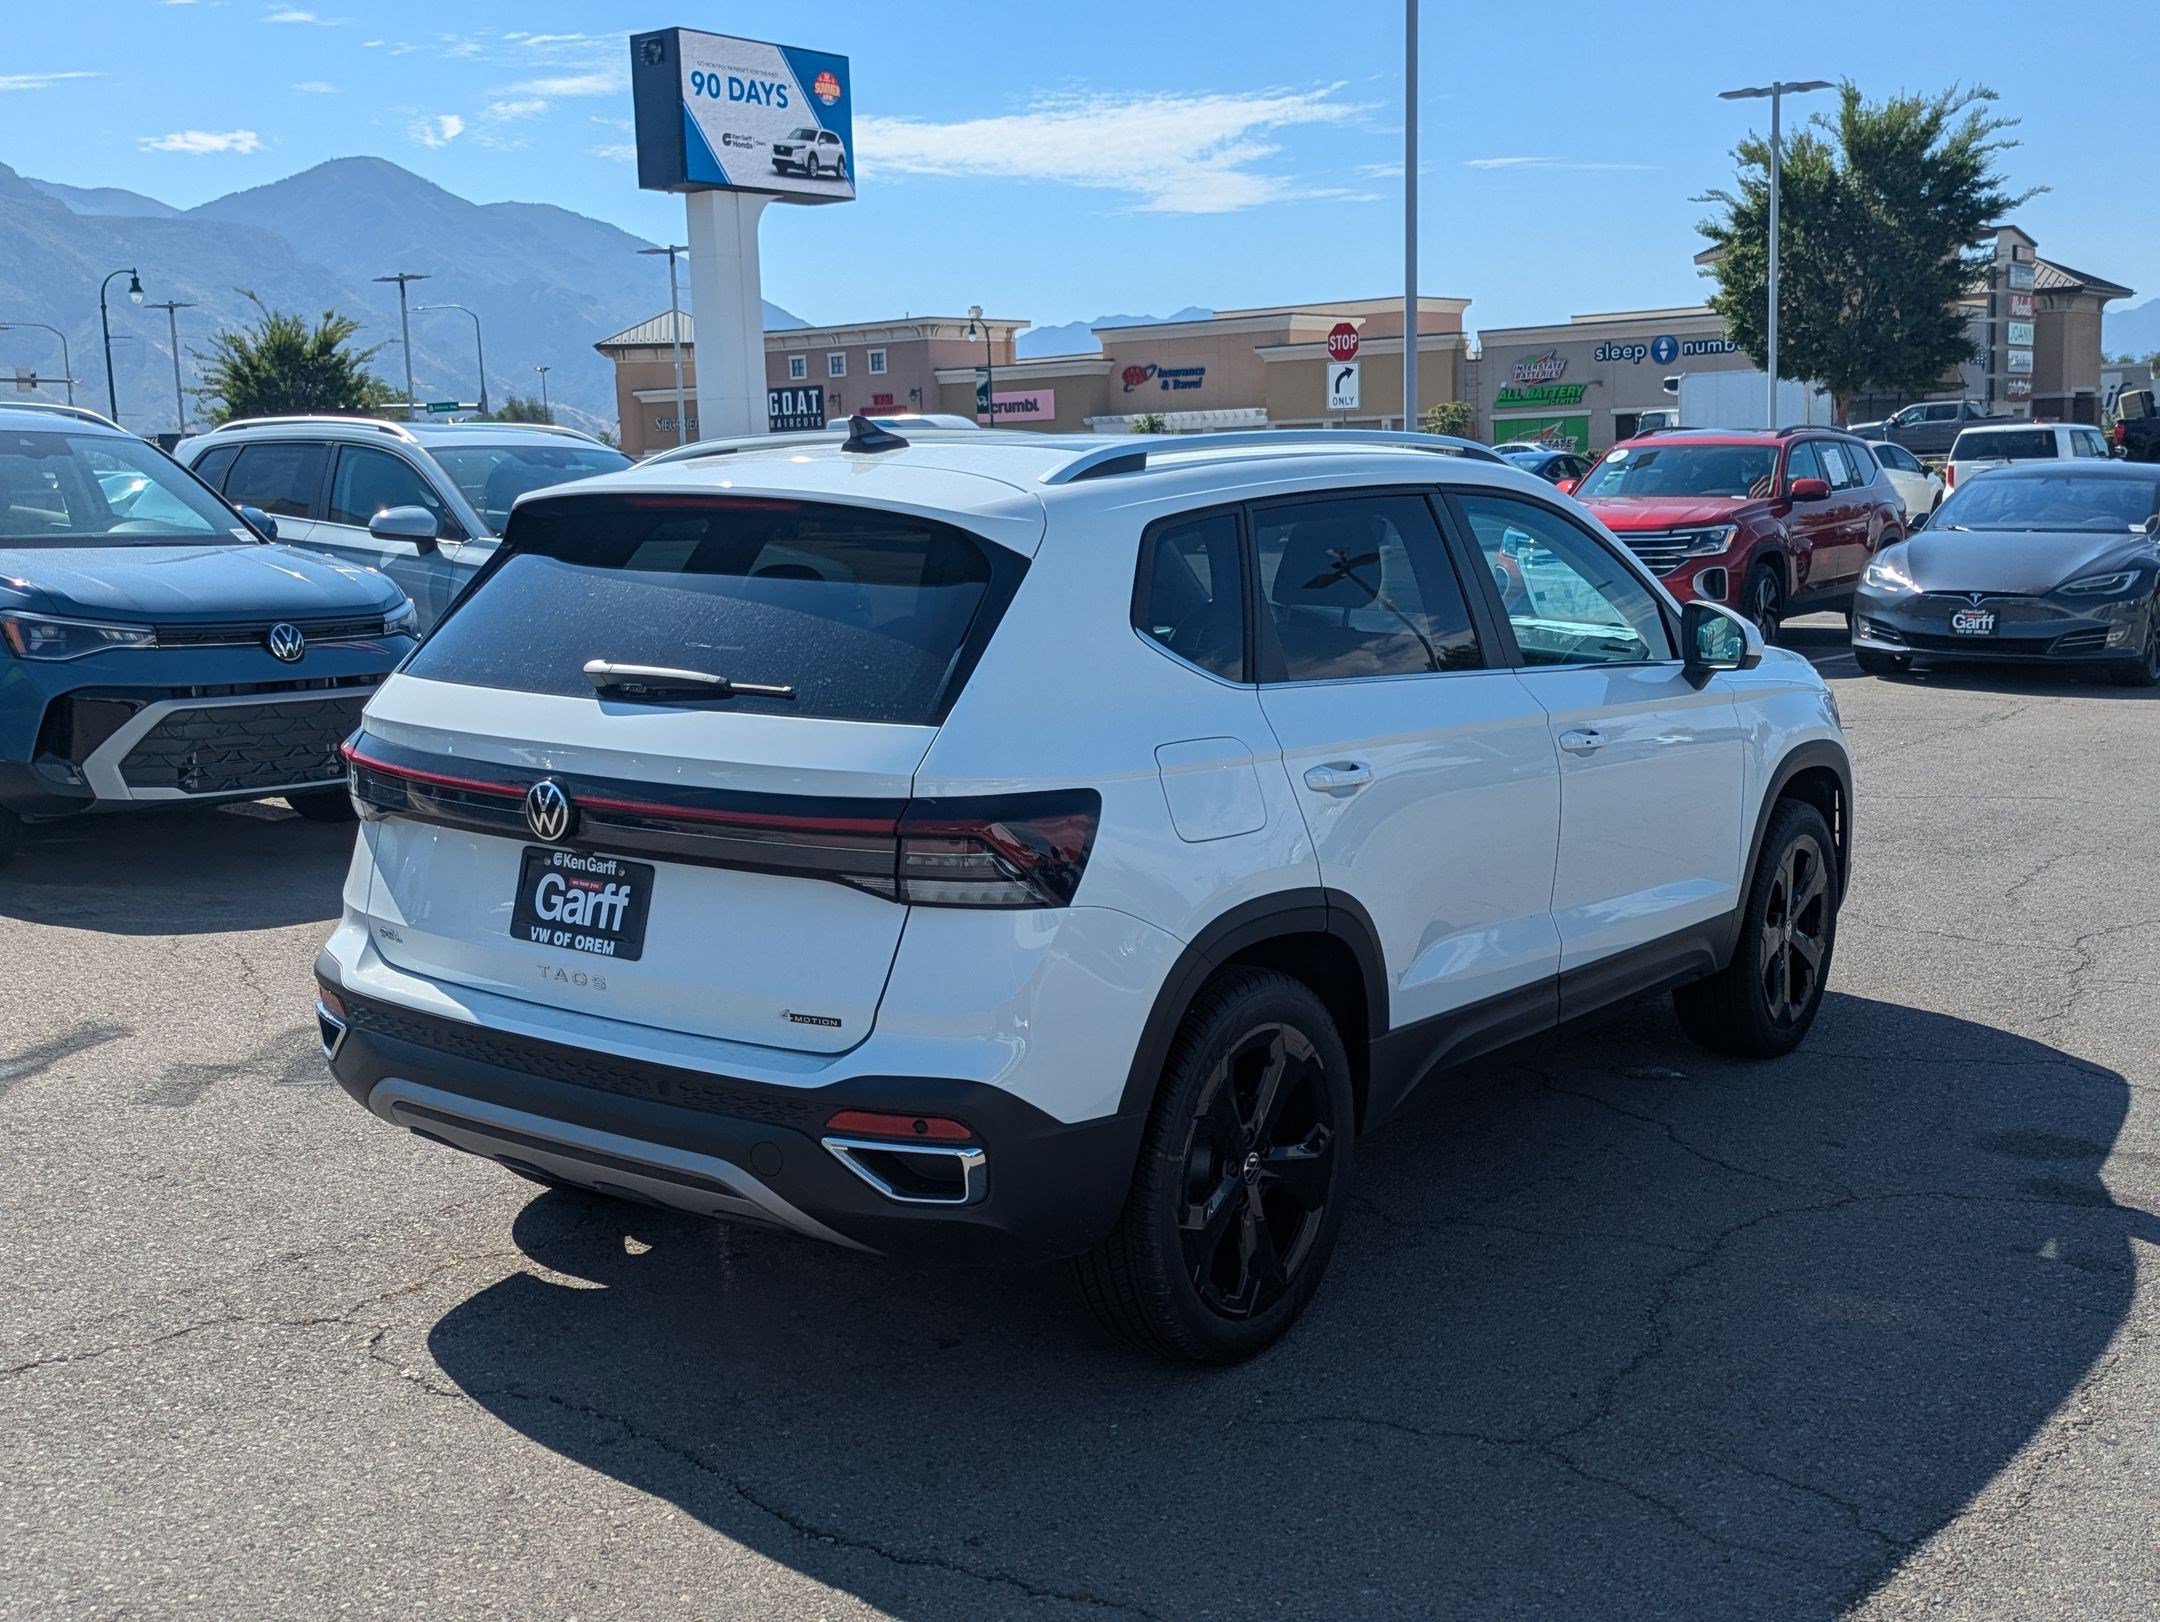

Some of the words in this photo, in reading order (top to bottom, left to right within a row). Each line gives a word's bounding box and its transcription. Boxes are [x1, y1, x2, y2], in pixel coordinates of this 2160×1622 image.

[691, 71, 721, 99] 90
[728, 76, 788, 109] DAYS
[733, 141, 753, 150] Honda
[1329, 334, 1358, 351] STOP
[1594, 343, 1645, 363] sleep
[1157, 367, 1206, 379] Insurance
[1512, 360, 1566, 373] INTERSTATE
[1172, 377, 1203, 390] Travel
[1514, 370, 1563, 381] BATTERIES
[1332, 395, 1355, 407] ONLY
[1498, 389, 1523, 401] ALL
[1526, 385, 1586, 399] BATTERY
[768, 389, 821, 416] G.O.A.T.
[991, 397, 1040, 414] crumbl
[770, 416, 822, 429] HAIRCUTS
[1952, 613, 1994, 630] Garff
[563, 853, 586, 871] Ken
[587, 857, 617, 875] Garff
[535, 872, 631, 932] Garff
[530, 926, 552, 943] VW
[553, 931, 573, 947] OF
[574, 935, 616, 956] OREM
[536, 964, 607, 991] TAOS
